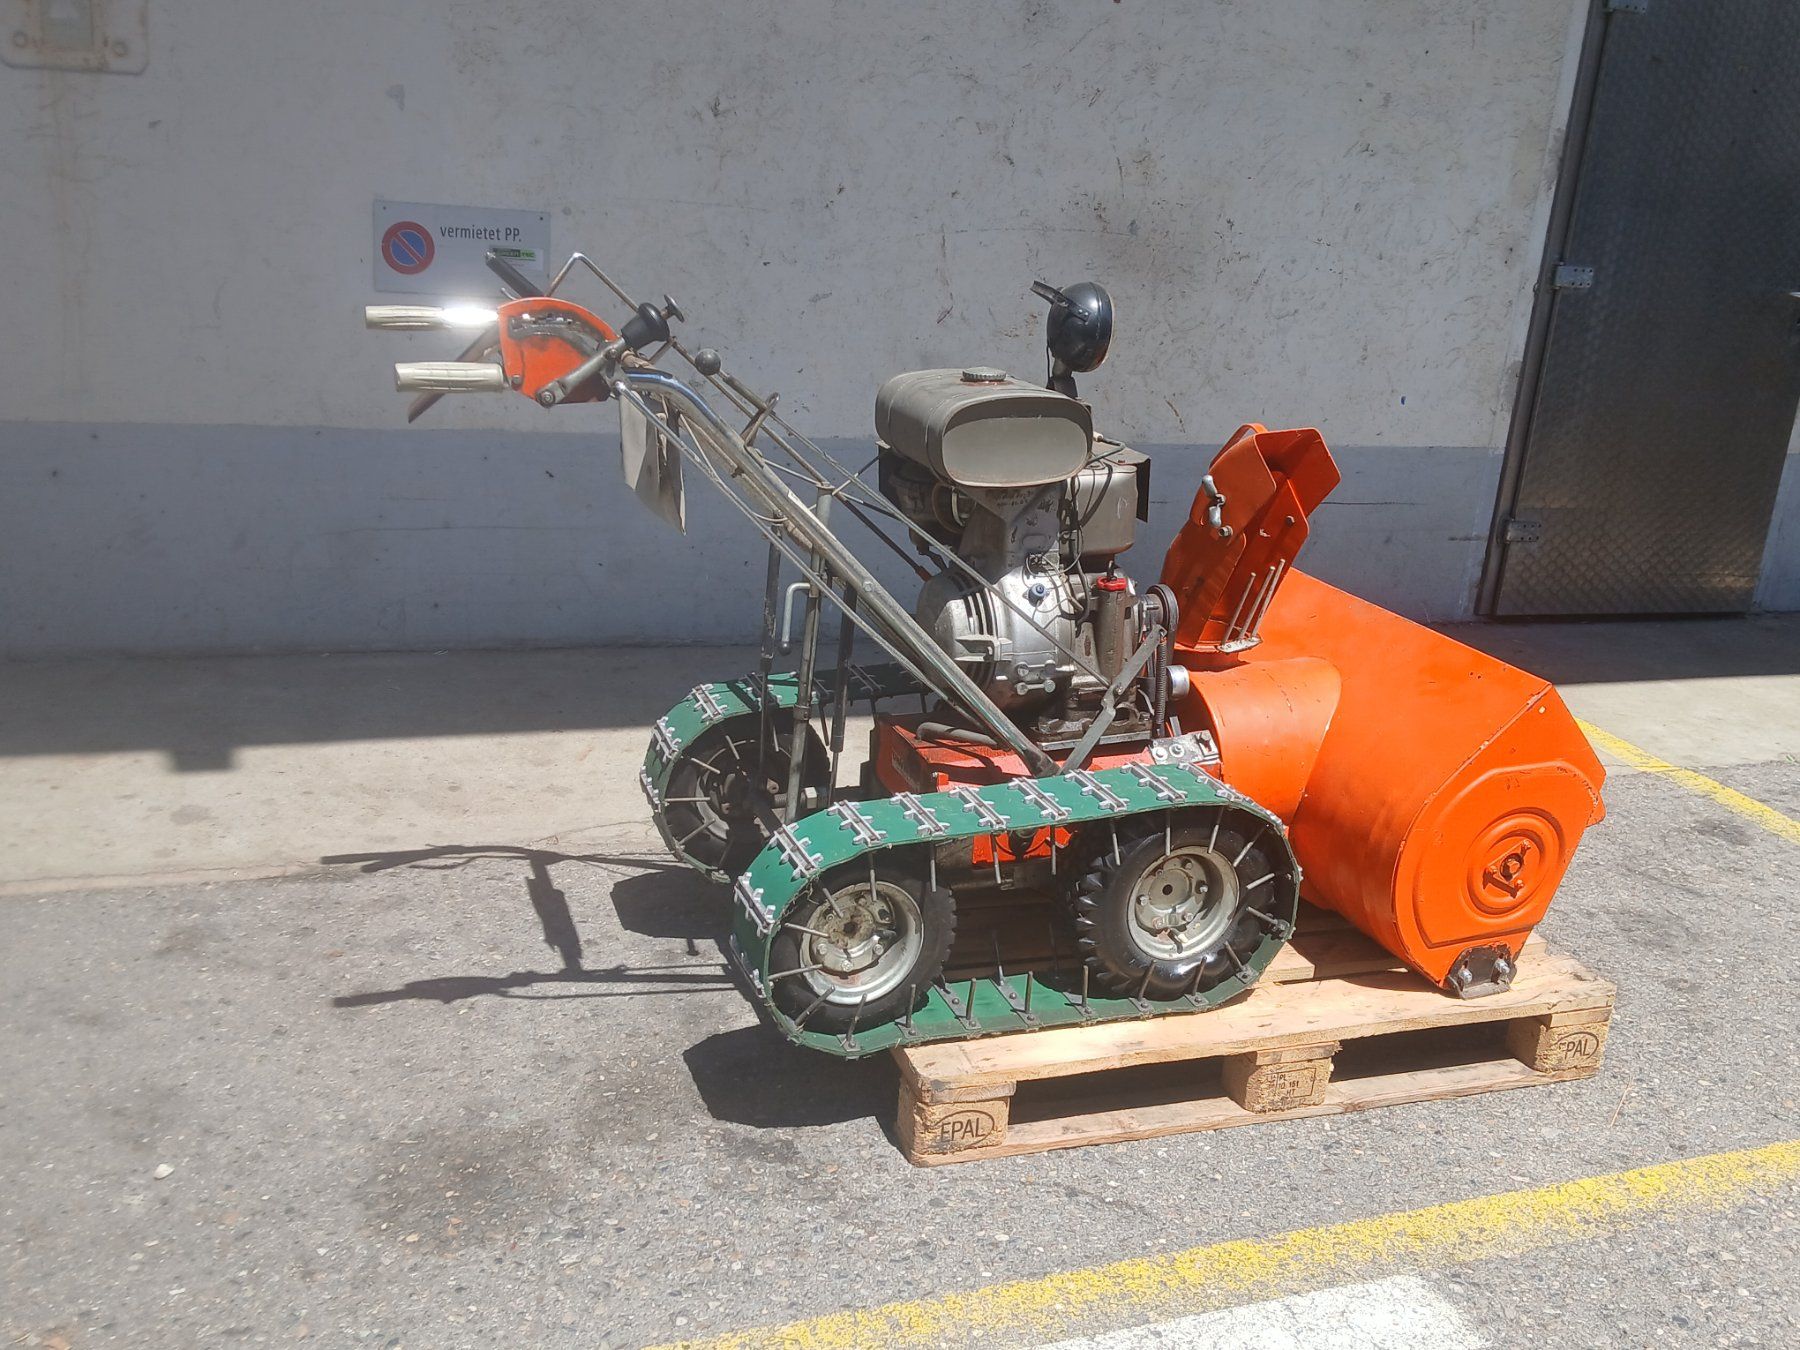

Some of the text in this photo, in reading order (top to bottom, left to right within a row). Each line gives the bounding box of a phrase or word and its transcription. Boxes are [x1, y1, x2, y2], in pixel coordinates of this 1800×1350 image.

[440, 224, 522, 242] vermietet PP.
[940, 1117, 986, 1141] EPAL
